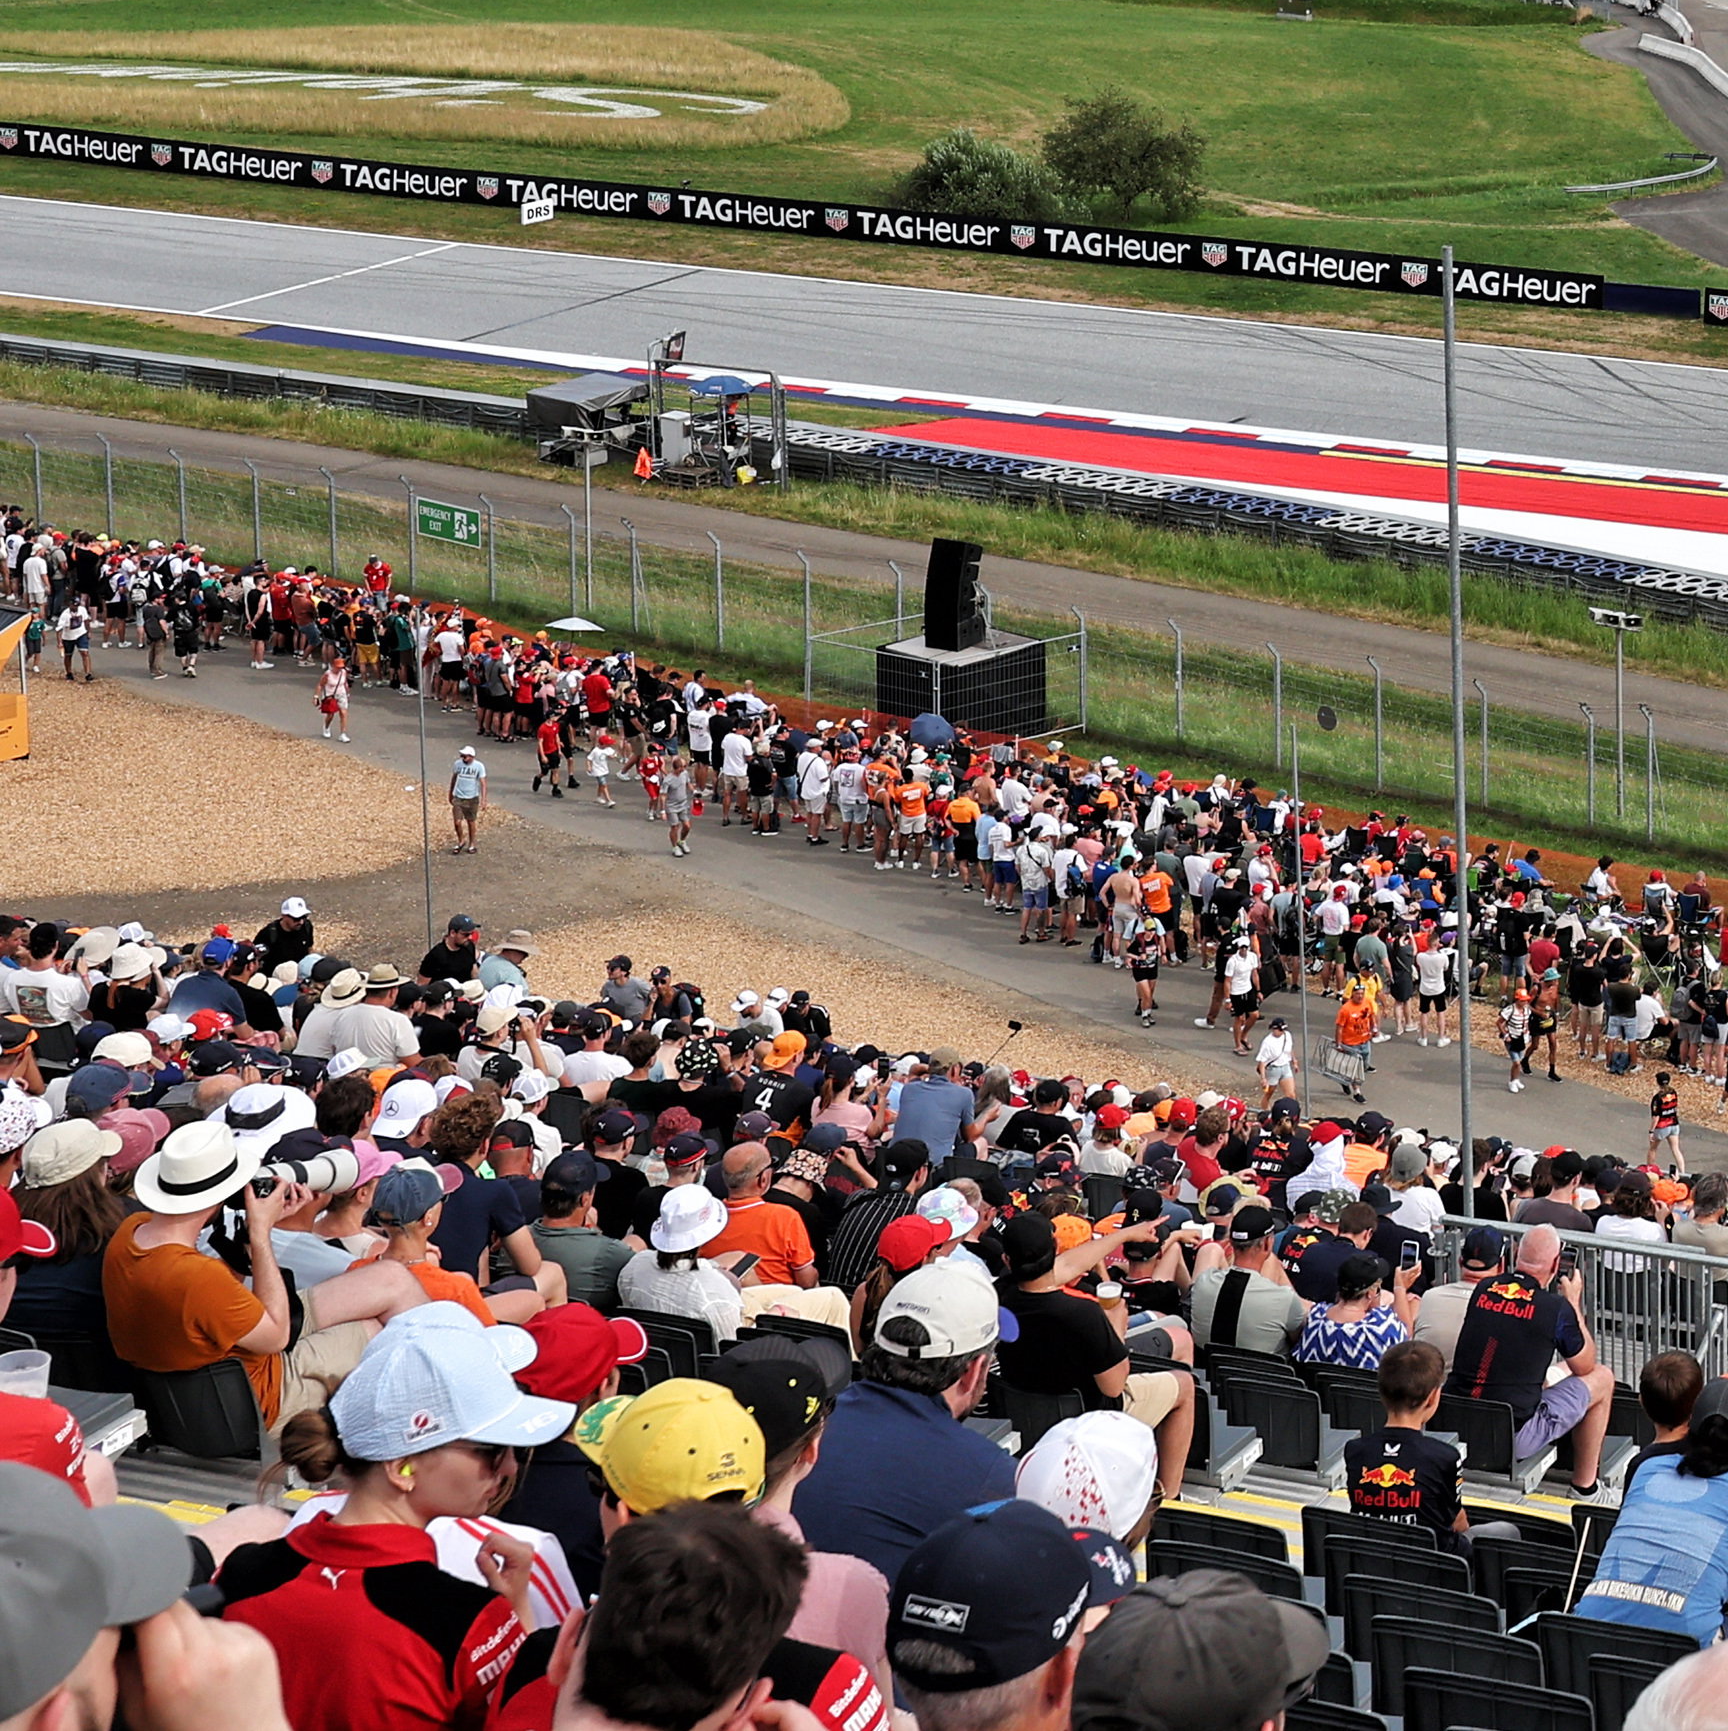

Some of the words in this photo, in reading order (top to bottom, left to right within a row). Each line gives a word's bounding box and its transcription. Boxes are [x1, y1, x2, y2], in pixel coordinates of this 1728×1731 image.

[527, 206, 550, 220] DRS
[419, 505, 450, 521] EMERGENCY
[429, 520, 442, 531] EXIT
[754, 1086, 774, 1112] 4
[1476, 1294, 1502, 1313] Red
[1504, 1301, 1535, 1320] Bull
[1354, 1489, 1381, 1506] Red
[1384, 1491, 1420, 1508] Bull
